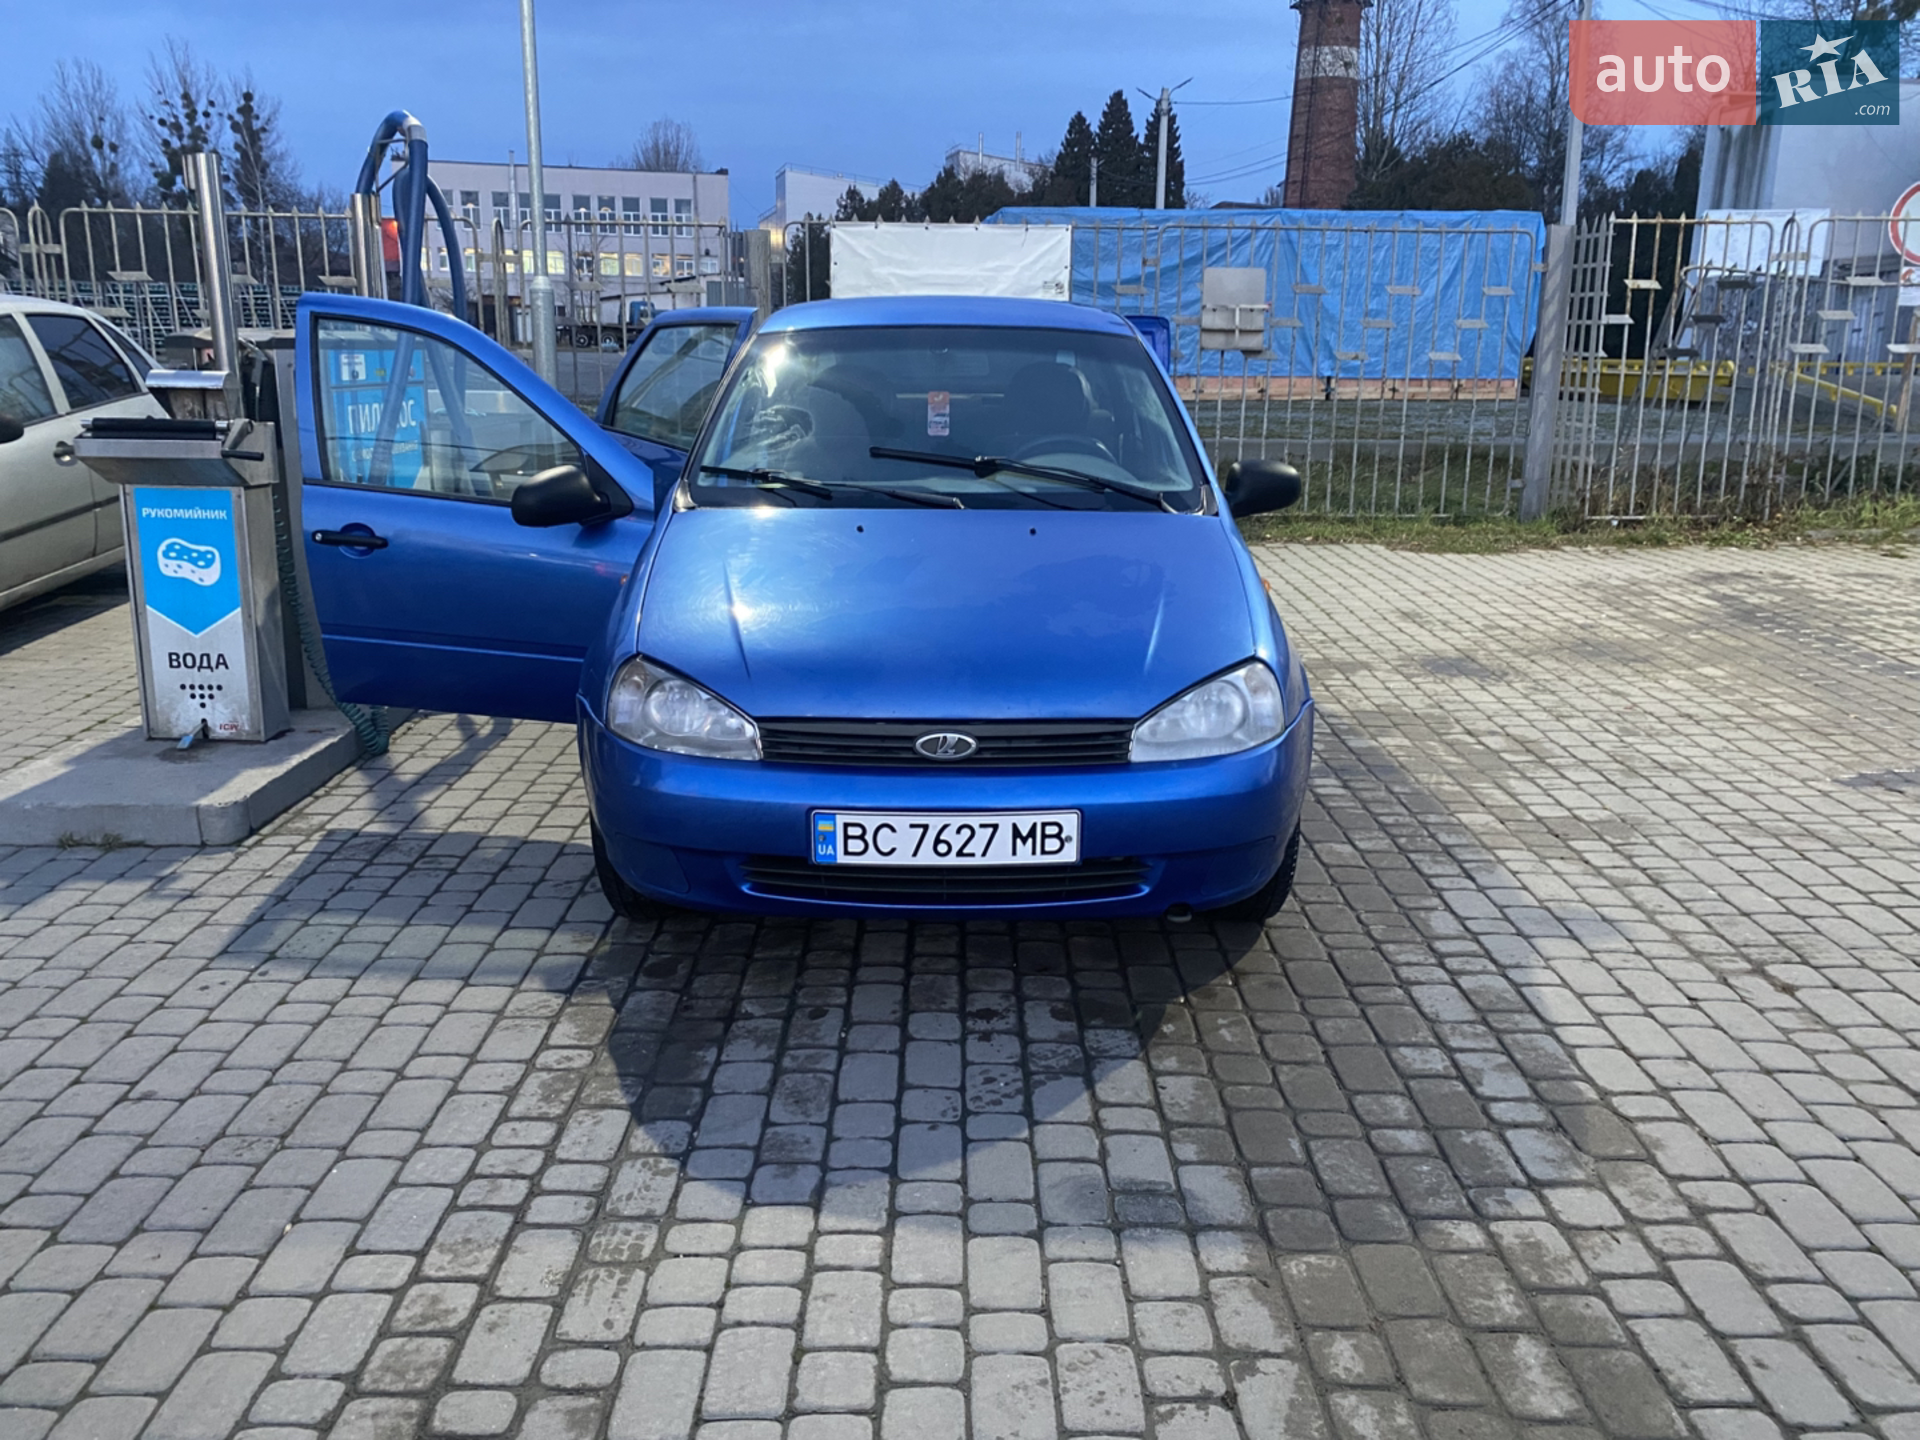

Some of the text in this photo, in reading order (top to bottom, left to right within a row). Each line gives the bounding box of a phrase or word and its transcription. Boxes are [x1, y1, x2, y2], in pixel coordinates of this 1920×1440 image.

[347, 400, 417, 434] ПИЛОС
[141, 506, 228, 520] РУКОМИЙНИК
[168, 652, 229, 673] ВОДА
[818, 844, 835, 855] UA
[843, 821, 1065, 857] BC 7627 MB
